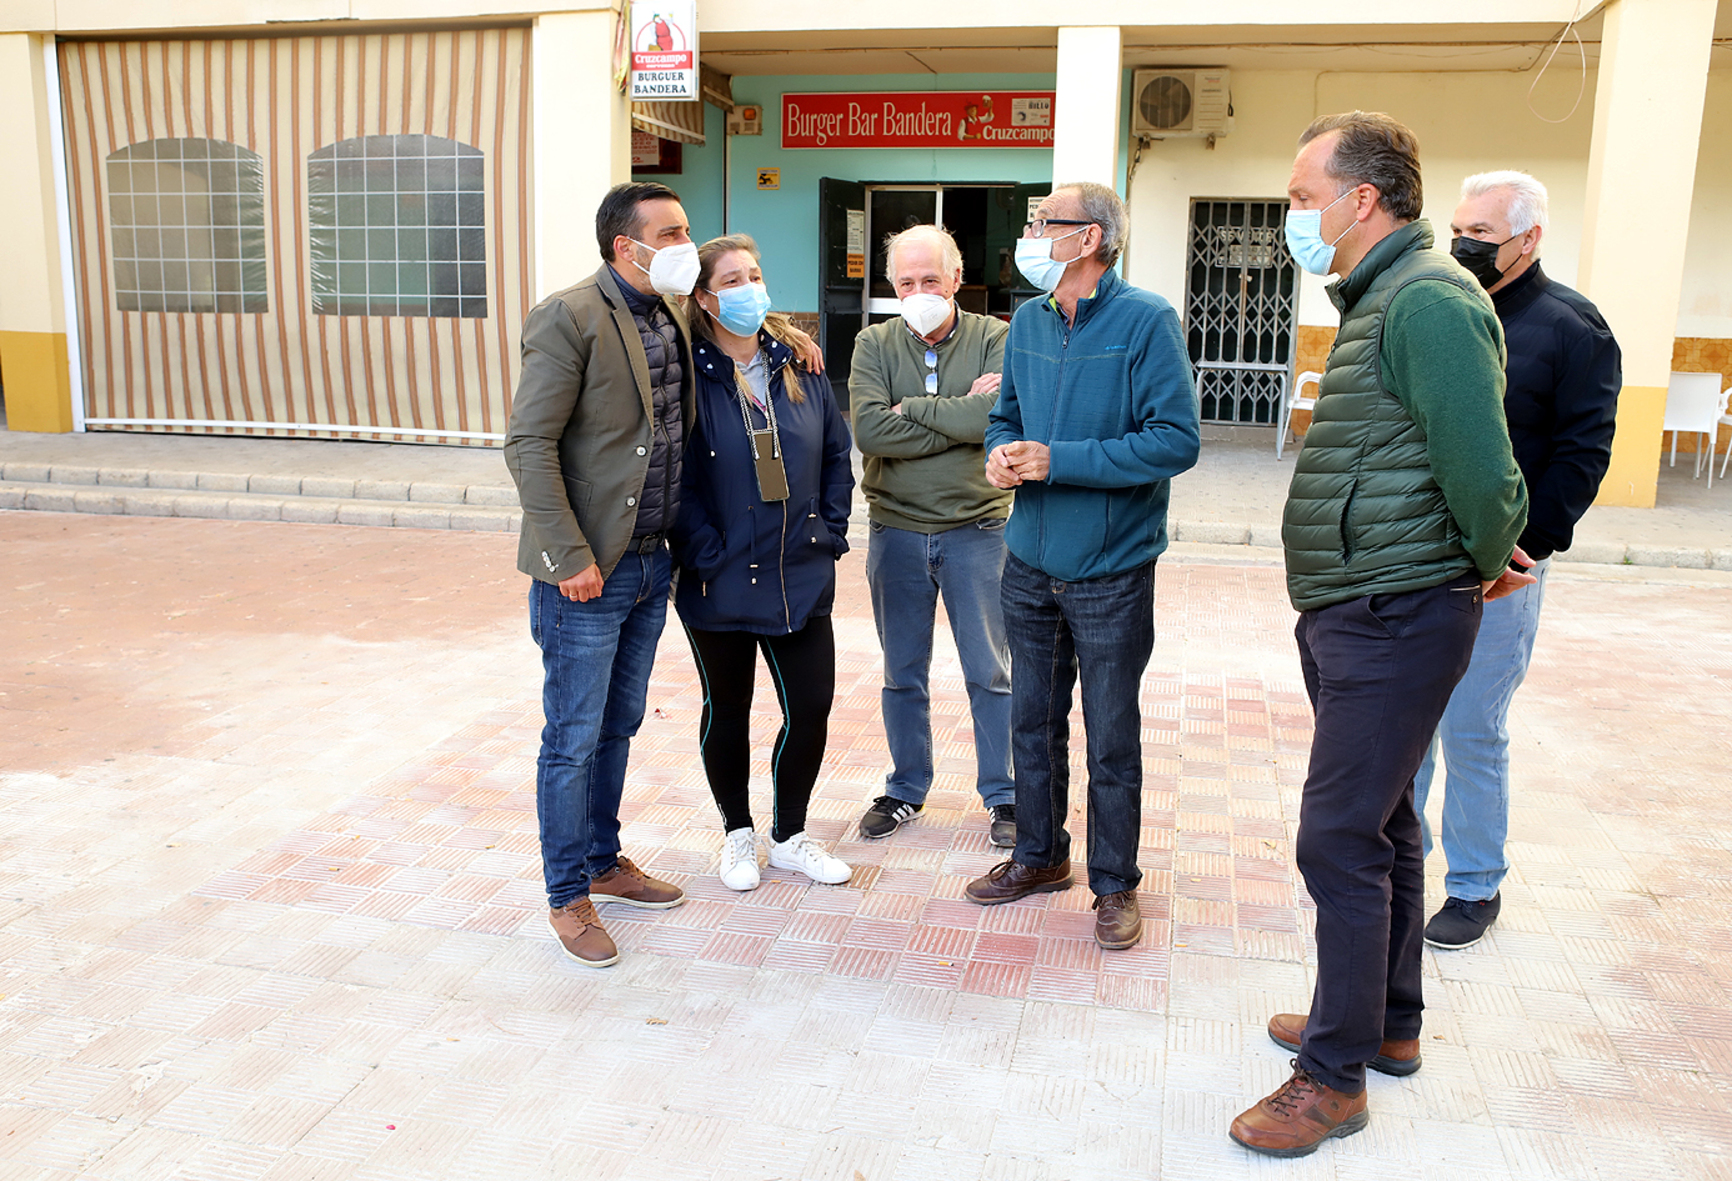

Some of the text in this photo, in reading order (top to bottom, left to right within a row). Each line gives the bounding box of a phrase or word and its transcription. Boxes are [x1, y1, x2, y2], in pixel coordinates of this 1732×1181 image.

[634, 54, 687, 65] Cruzcampo
[638, 71, 685, 81] BURGUER
[634, 84, 687, 93] BANDERA
[787, 101, 952, 146] Burger Bar Bandera
[982, 125, 1055, 143] Cruzcampo
